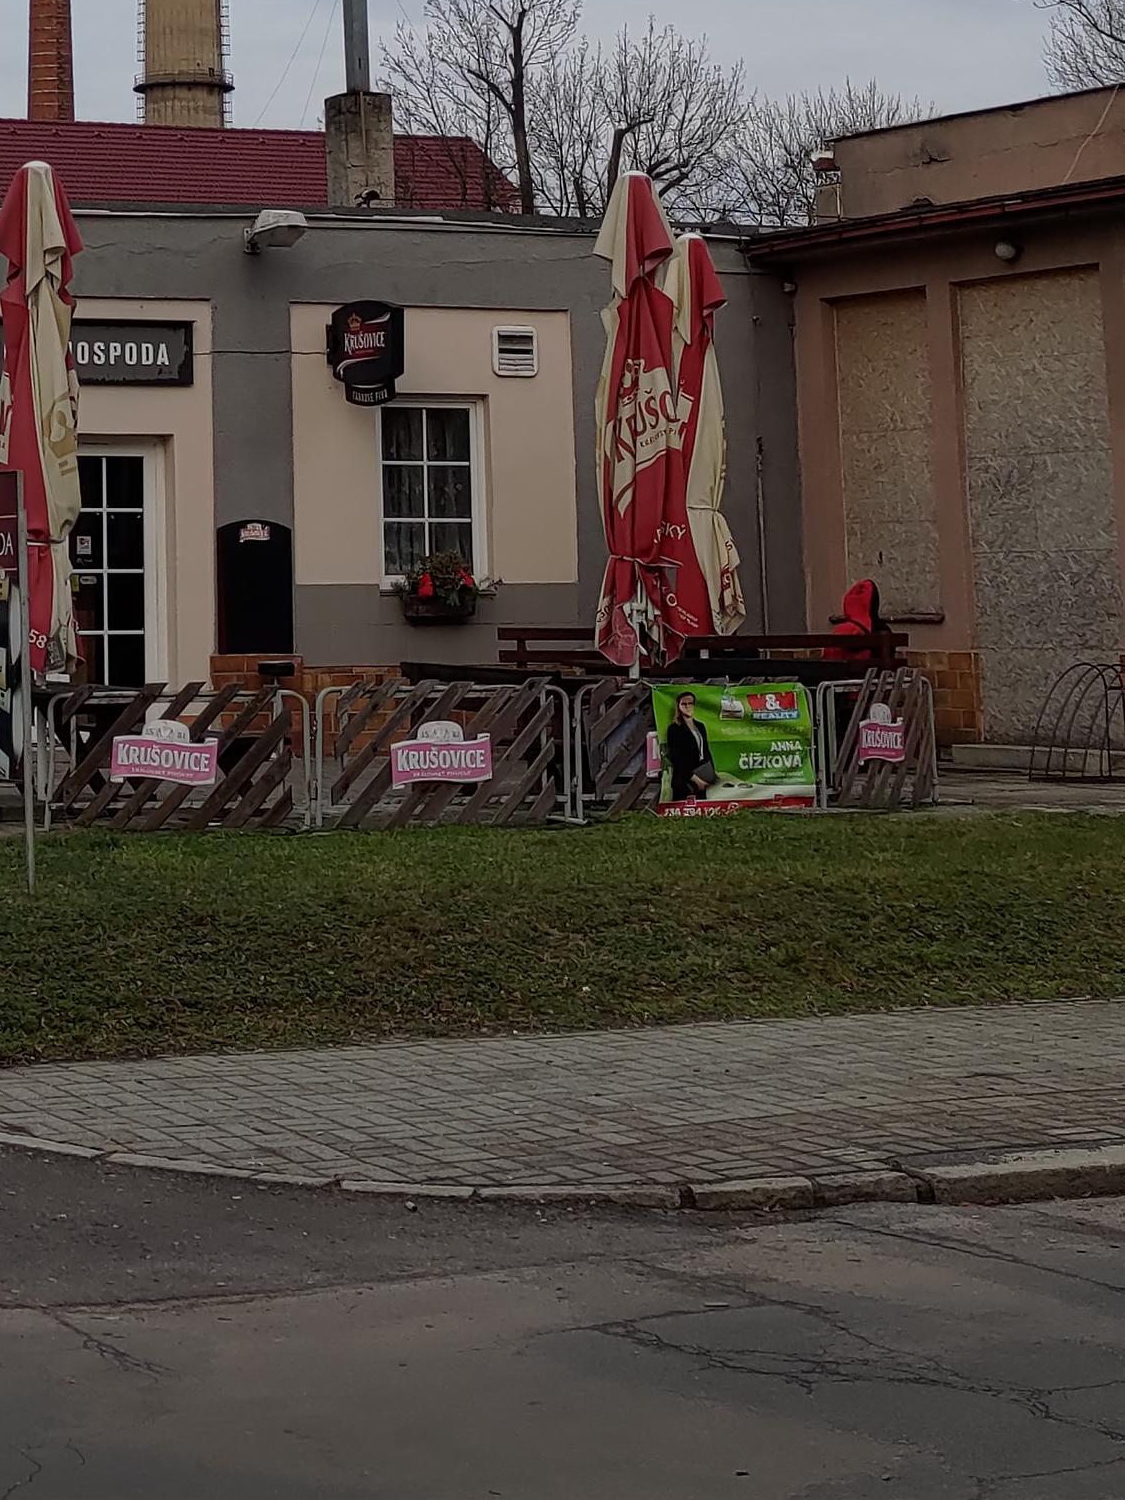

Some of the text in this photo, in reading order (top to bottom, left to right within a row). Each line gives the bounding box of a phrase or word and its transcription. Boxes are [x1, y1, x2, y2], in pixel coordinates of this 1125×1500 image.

[344, 331, 386, 355] KRUŠOVICE
[770, 740, 803, 752] ANNA
[862, 727, 904, 749] KRUŠOVICE
[117, 743, 211, 772] KRUŠOVICE
[396, 747, 486, 771] KRUŠOVICE
[739, 752, 803, 770] ČÍŽKOVÁ
